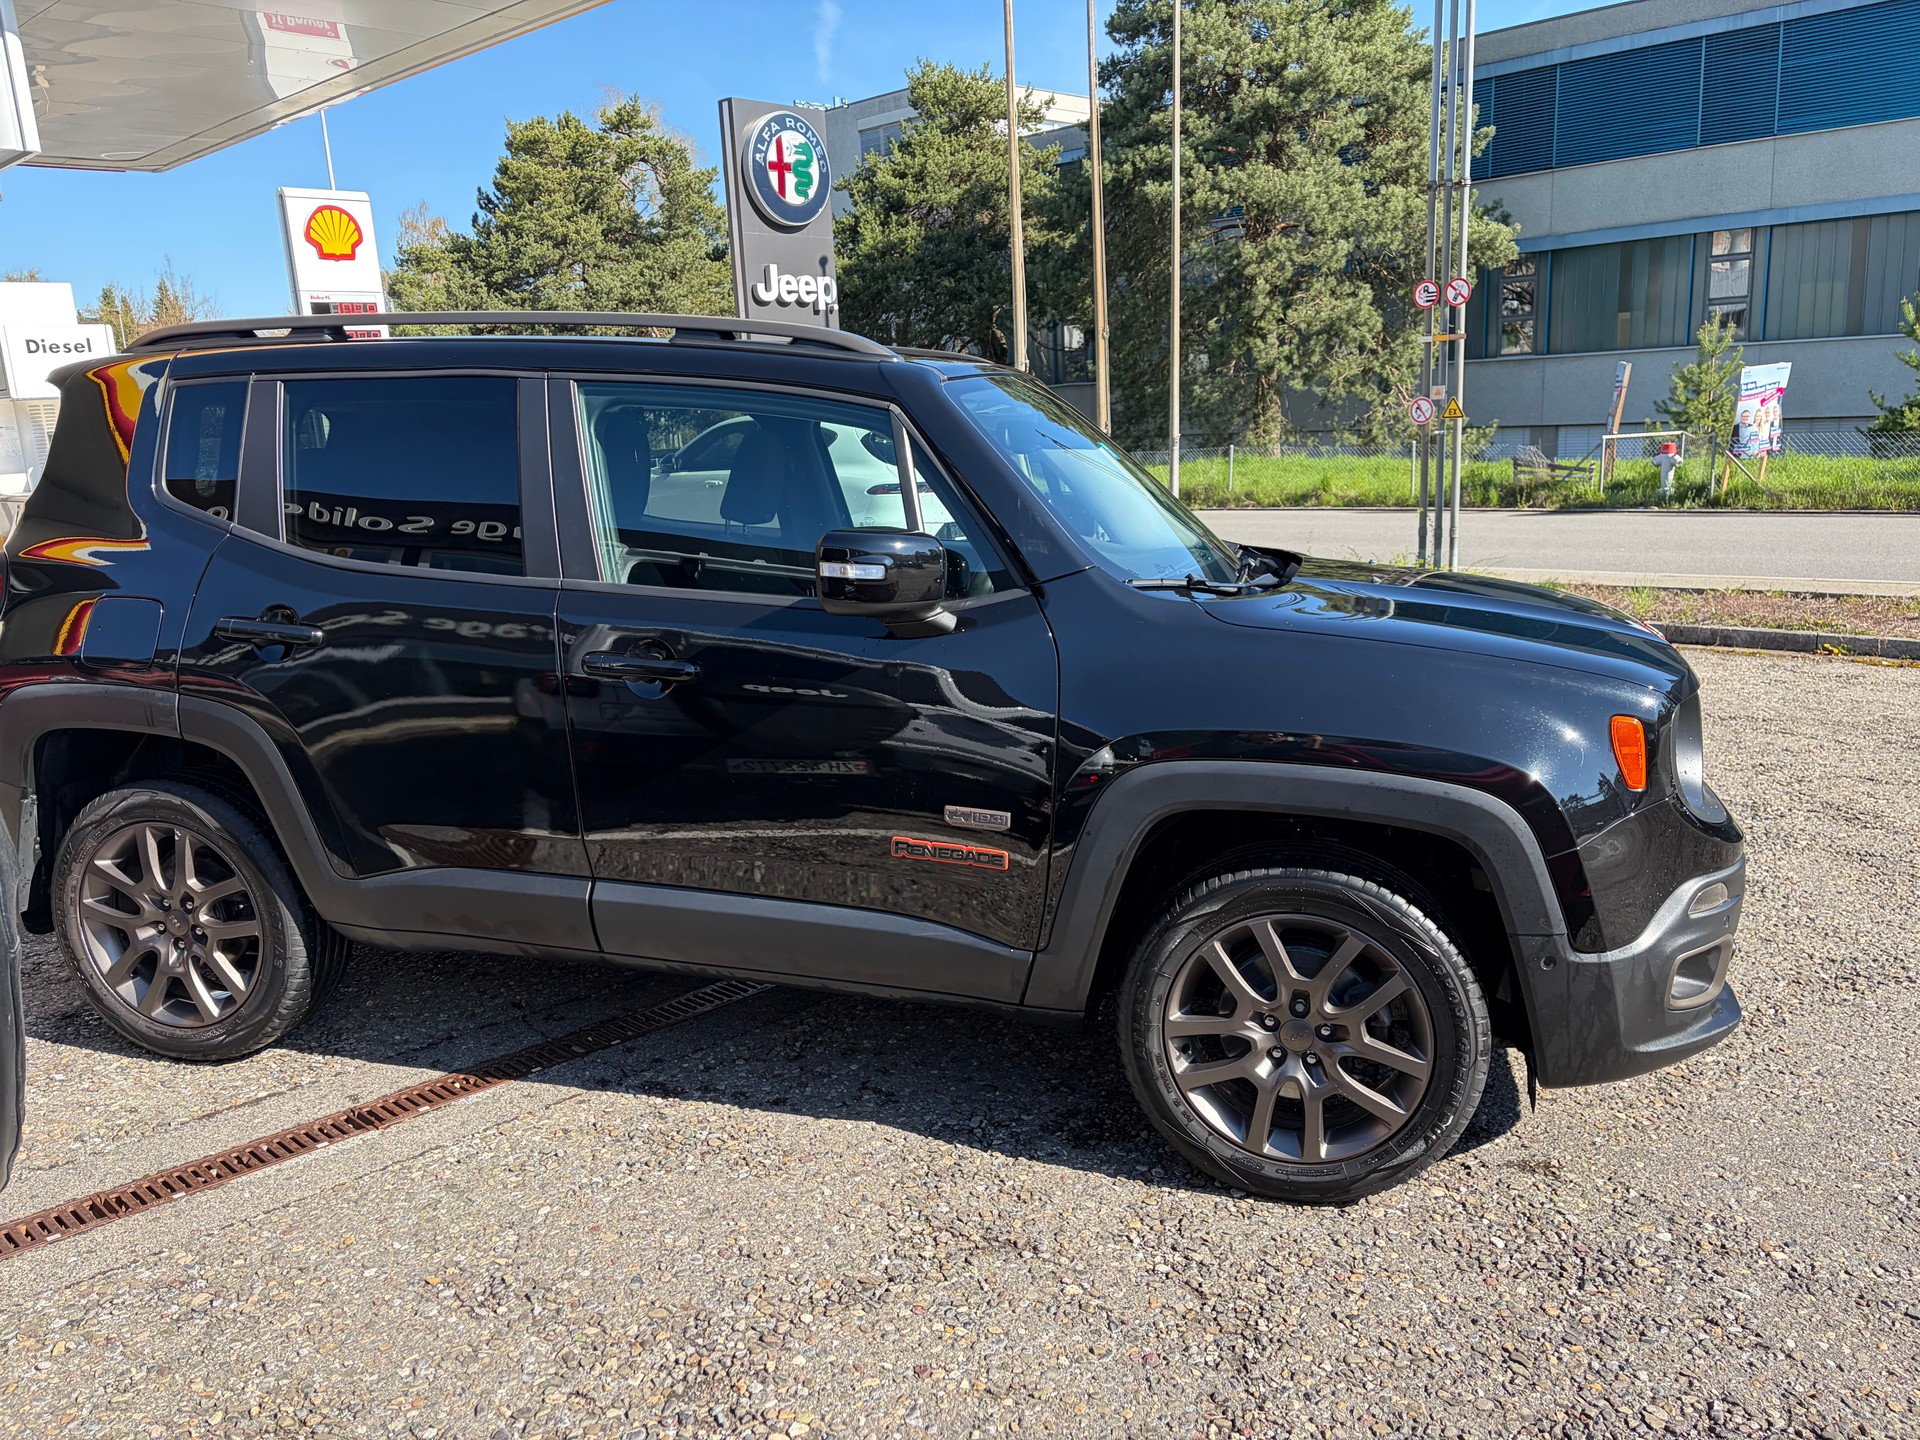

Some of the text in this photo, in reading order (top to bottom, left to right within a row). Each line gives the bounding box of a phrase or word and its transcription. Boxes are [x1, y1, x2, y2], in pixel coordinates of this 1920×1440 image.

[756, 117, 827, 174] ALFA ROMEO
[756, 263, 837, 311] Jeep
[25, 337, 93, 354] Diesel
[1448, 408, 1458, 416] EX
[973, 811, 1007, 825] 1941
[892, 838, 1007, 869] RENEGADE
[1445, 1037, 1471, 1107] GREEN
